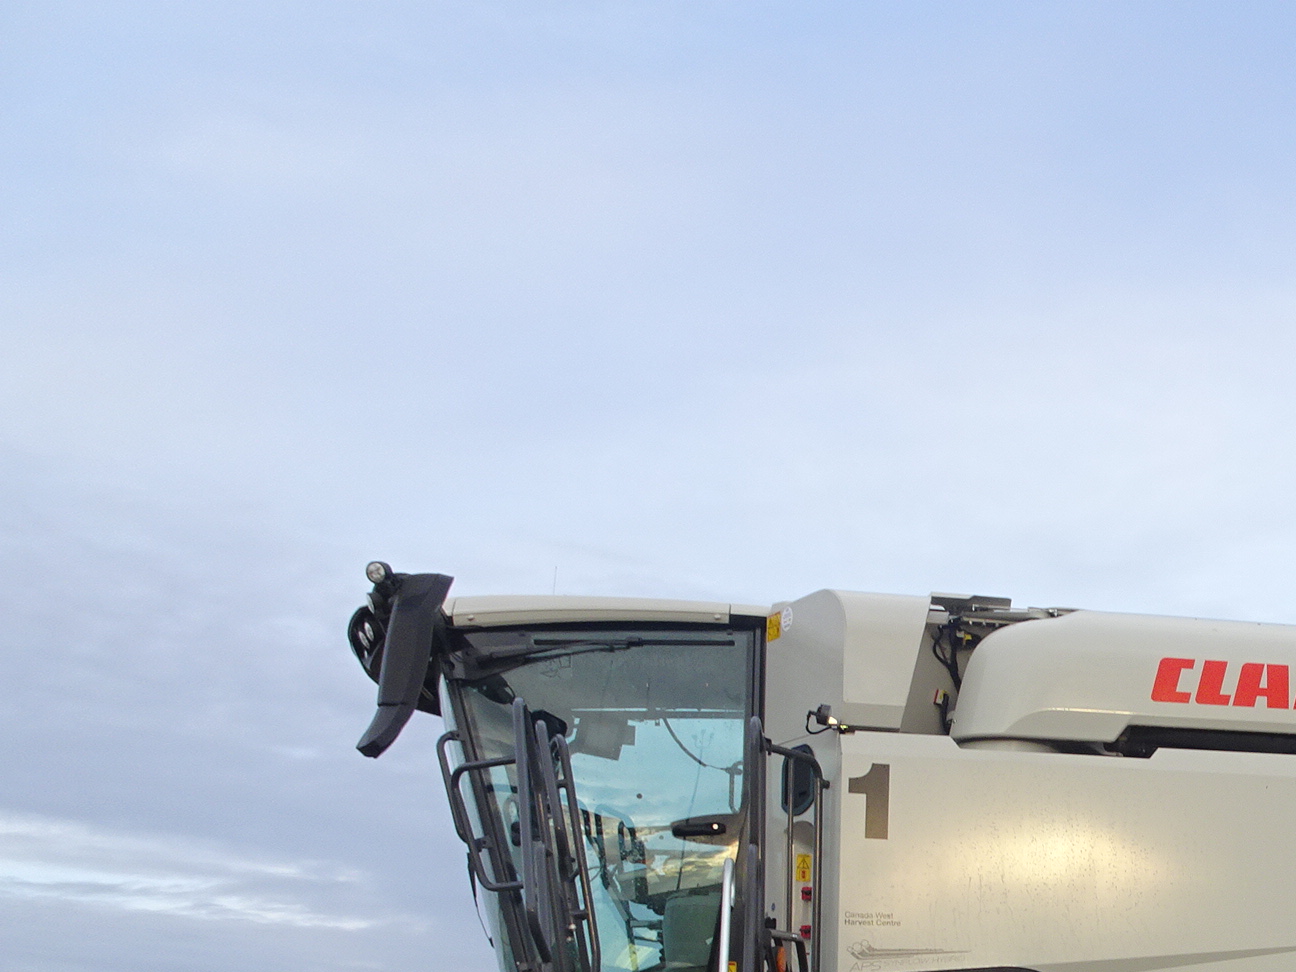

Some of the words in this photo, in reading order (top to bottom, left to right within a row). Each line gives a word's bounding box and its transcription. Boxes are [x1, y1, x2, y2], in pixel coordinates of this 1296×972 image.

[848, 763, 891, 840] 1
[844, 911, 874, 920] Canada
[875, 912, 894, 920] West
[844, 918, 874, 927] Harvest
[875, 919, 902, 927] Centre
